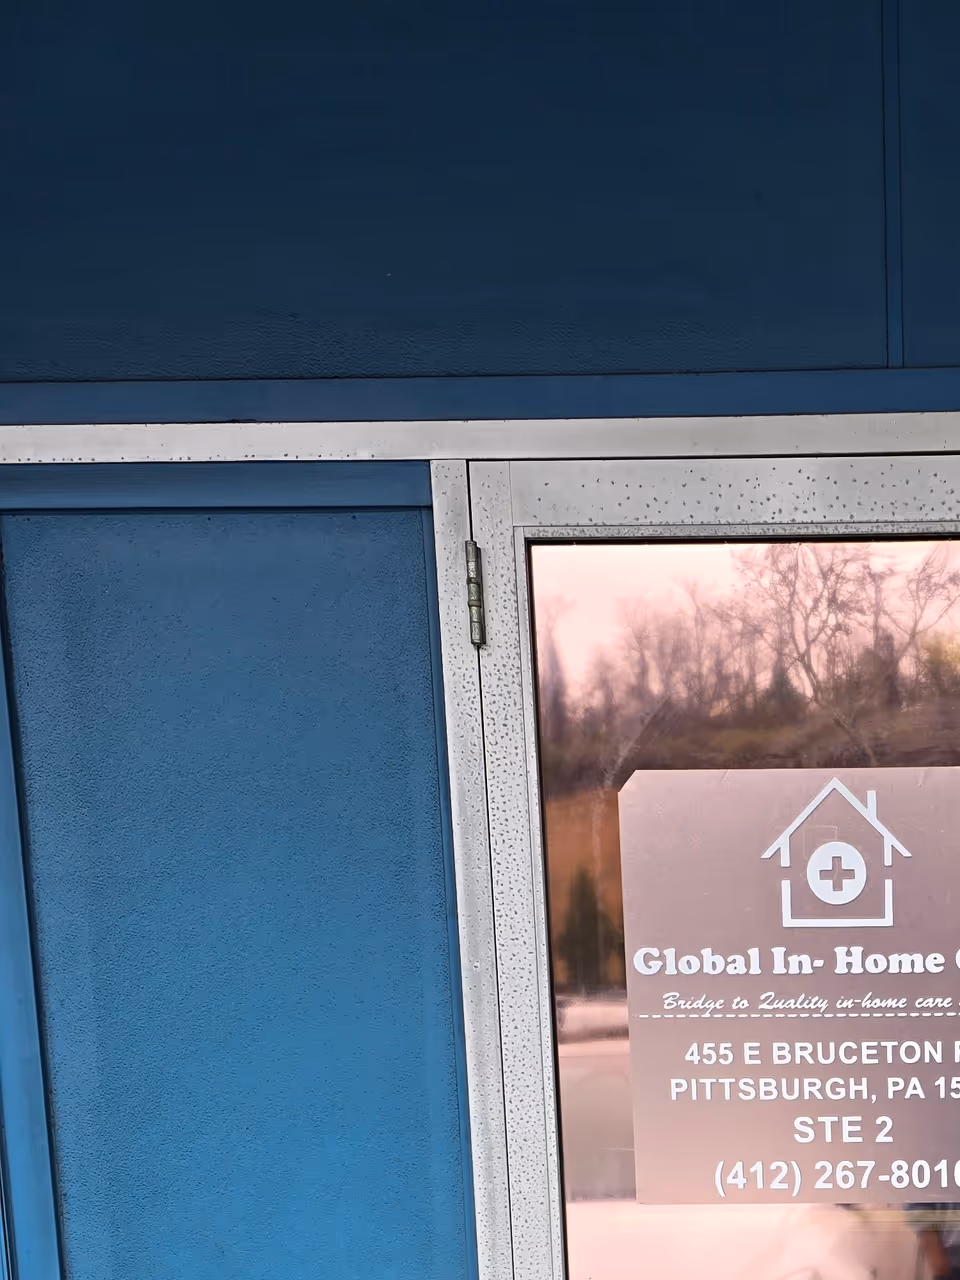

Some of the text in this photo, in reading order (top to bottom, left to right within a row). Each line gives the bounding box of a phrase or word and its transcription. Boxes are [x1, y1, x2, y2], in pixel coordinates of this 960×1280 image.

[632, 947, 762, 976] Global
[770, 947, 825, 975] In-
[833, 946, 946, 975] Home
[662, 991, 725, 1014] Bridge
[732, 995, 750, 1010] to
[757, 991, 830, 1014] Quality
[835, 991, 908, 1010] in-home
[914, 996, 953, 1009] care
[684, 1042, 734, 1065] 455
[743, 1042, 762, 1065] E
[772, 1040, 943, 1065] BRUCETON
[670, 1077, 877, 1104] PITTSBURGH,
[887, 1076, 926, 1100] PA
[793, 1115, 894, 1144] STE 2
[714, 1160, 802, 1197] (412)
